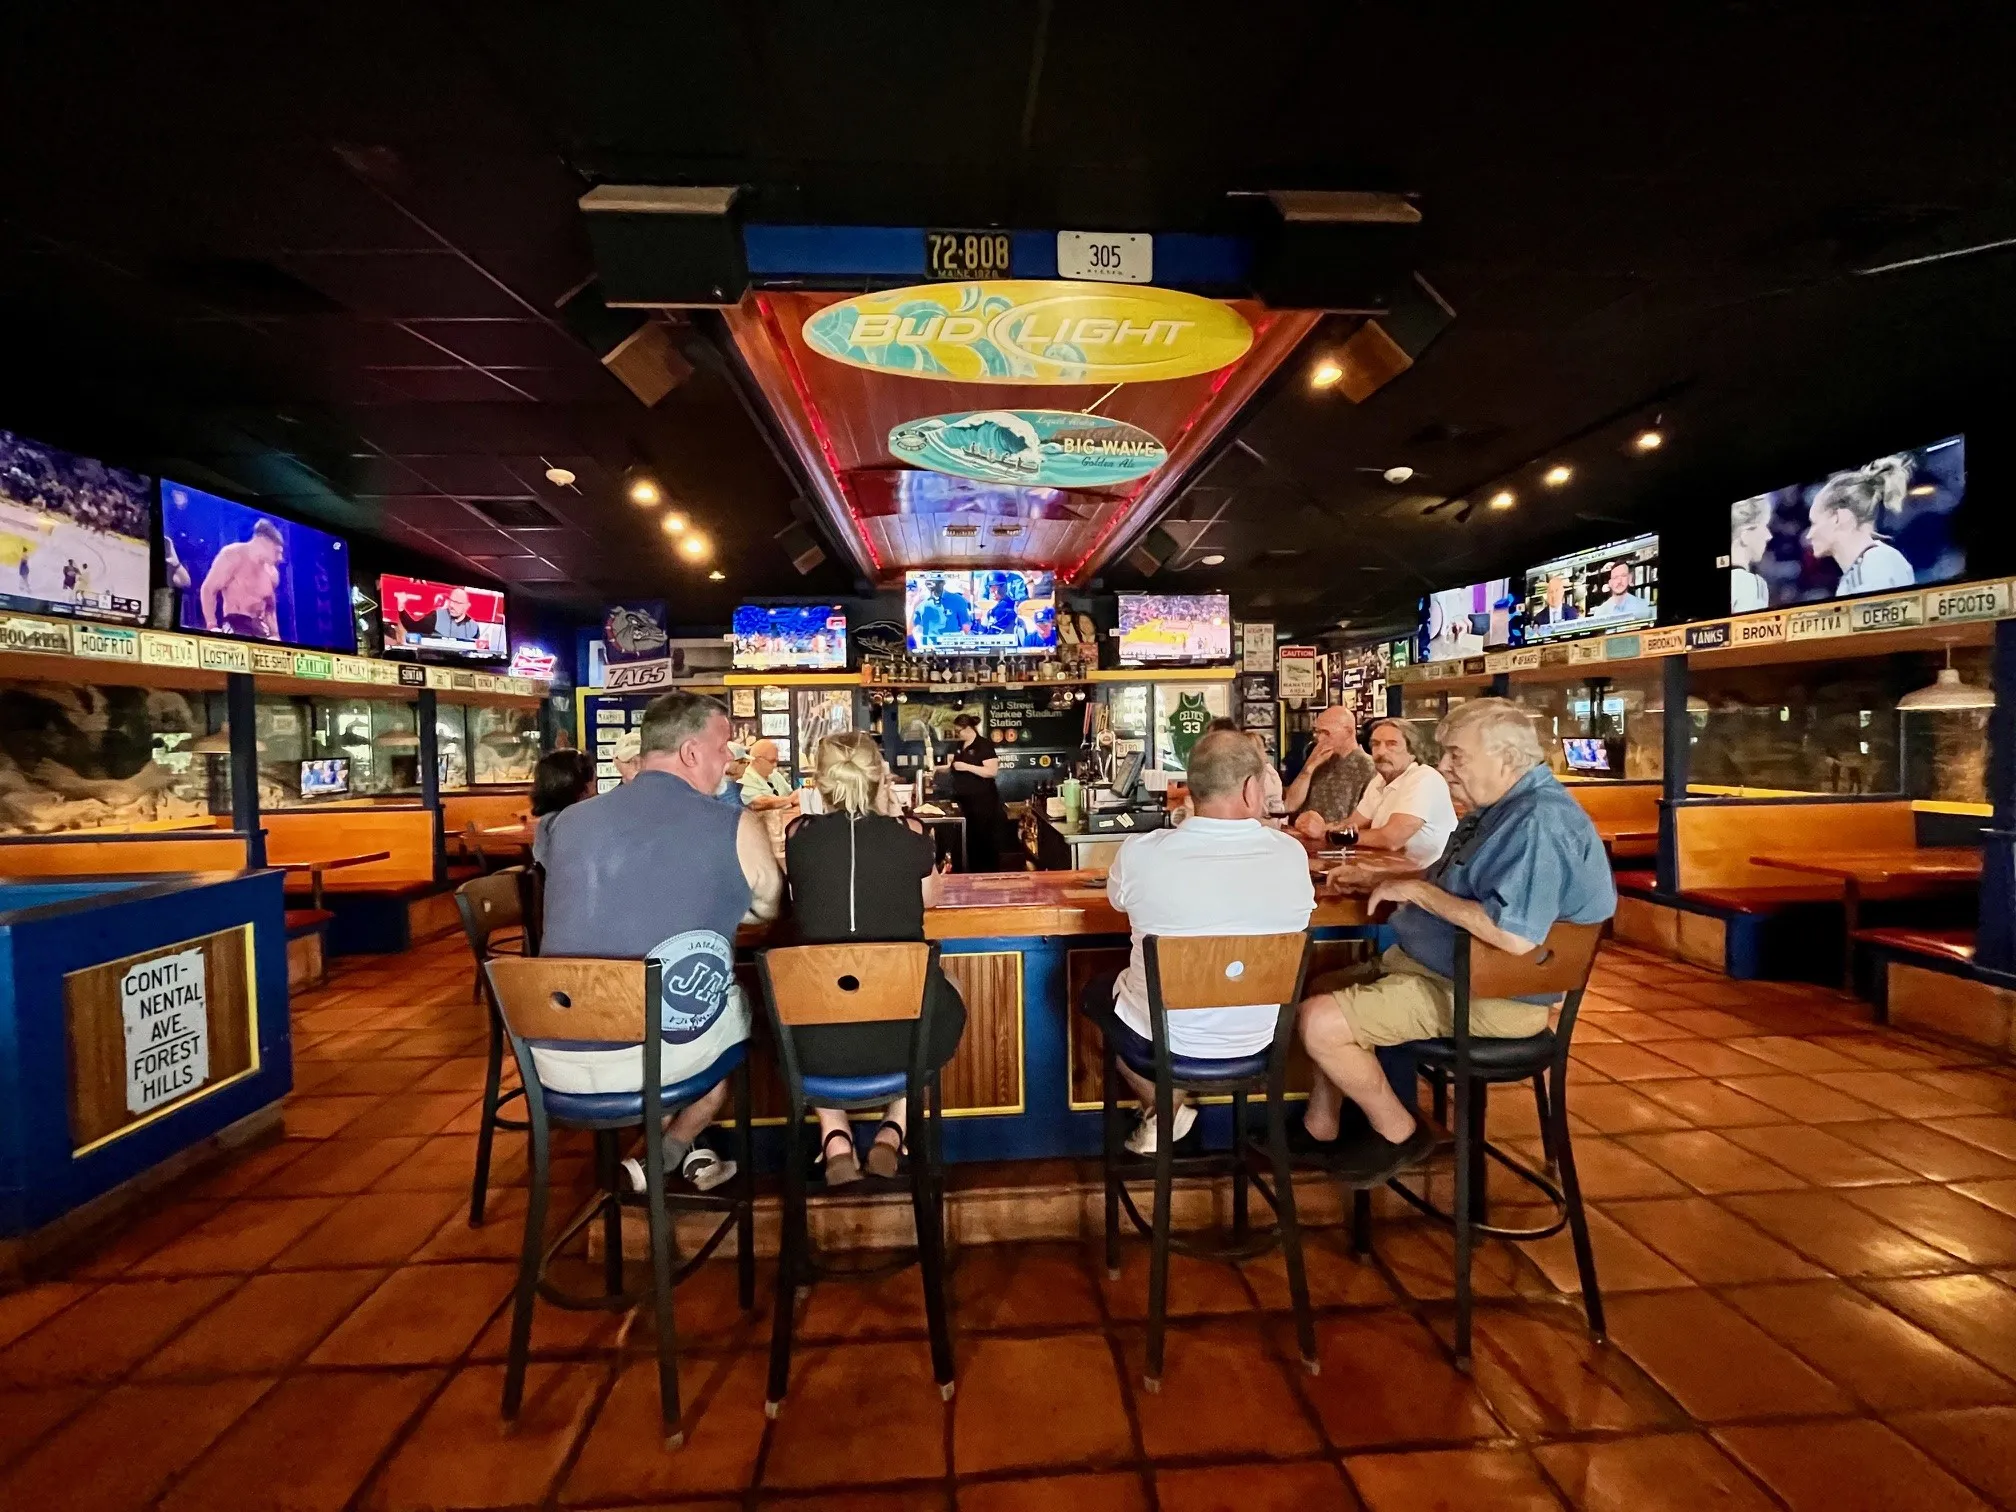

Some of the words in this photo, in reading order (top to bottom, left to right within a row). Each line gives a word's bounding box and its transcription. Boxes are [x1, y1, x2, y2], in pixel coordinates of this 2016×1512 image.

[1089, 244, 1121, 268] 305
[848, 314, 985, 346] BUD
[1016, 319, 1195, 346] LIGHT
[1063, 437, 1096, 454] BIG
[1101, 439, 1156, 458] WAVE
[1081, 456, 1114, 469] Golden
[1118, 458, 1135, 469] Ale
[1863, 604, 1909, 625] DERBY
[1742, 623, 1782, 640] BRONX
[1792, 615, 1842, 633] CAPTIVA
[1648, 635, 1682, 650] BROOKLYN
[1692, 629, 1724, 645] YANKS
[401, 669, 424, 682] SUNTAN
[606, 667, 667, 689] ZAGS
[990, 710, 1022, 718] Yankee
[1025, 709, 1063, 718] Stadium
[1007, 701, 1035, 710] Street
[990, 718, 1022, 727] Station
[1179, 710, 1204, 722] CELTICS
[1182, 721, 1201, 734] 33
[125, 963, 188, 996] CONTI-
[140, 982, 202, 1019] NENTAL
[151, 1013, 187, 1042] AVE.
[134, 1035, 201, 1081] FOREST
[142, 1065, 193, 1103] HILLS
